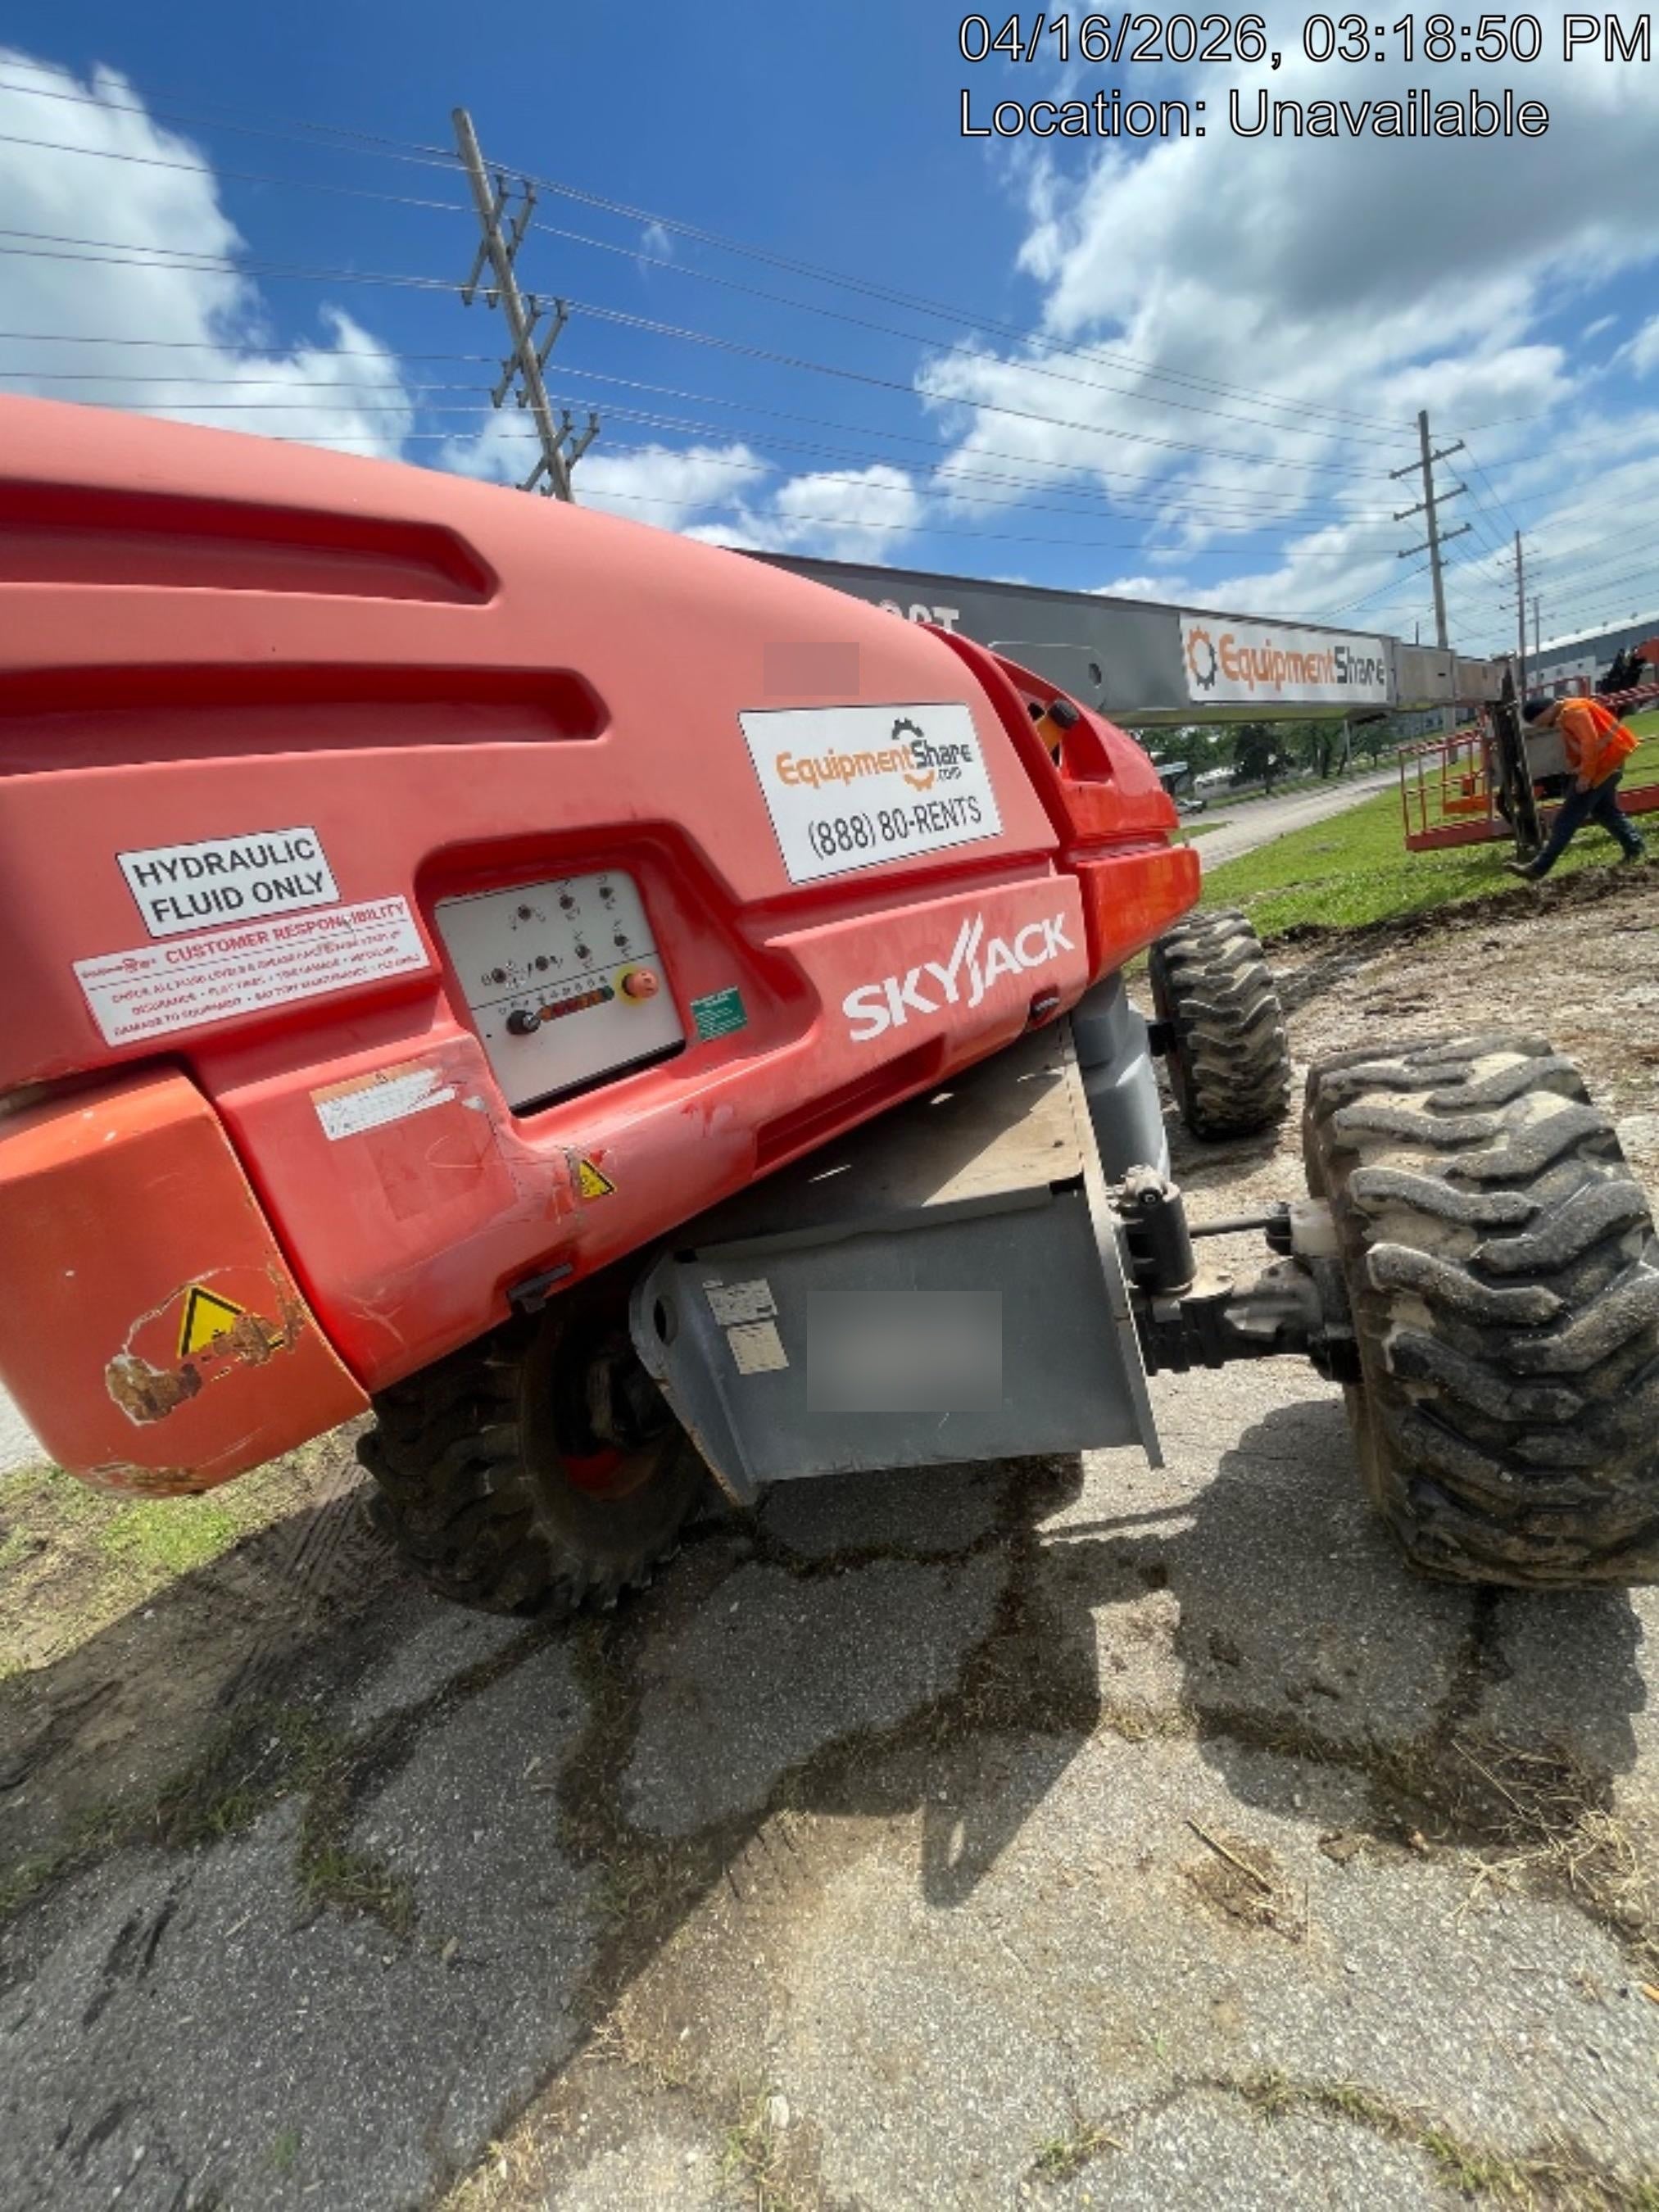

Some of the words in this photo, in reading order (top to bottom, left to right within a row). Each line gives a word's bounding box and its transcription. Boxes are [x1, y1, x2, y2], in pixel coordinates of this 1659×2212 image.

[1219, 634, 1385, 692] EquipmentShare
[776, 740, 973, 790] EquipmentShare
[808, 813, 876, 860] (888)
[877, 796, 981, 841] 80-RENTS
[132, 837, 315, 887] HYDRAULIC
[150, 886, 244, 922] FLUID
[252, 871, 324, 903] ONLY
[165, 930, 269, 965] CUSTOMER
[842, 912, 1075, 1040] SKYJACK
